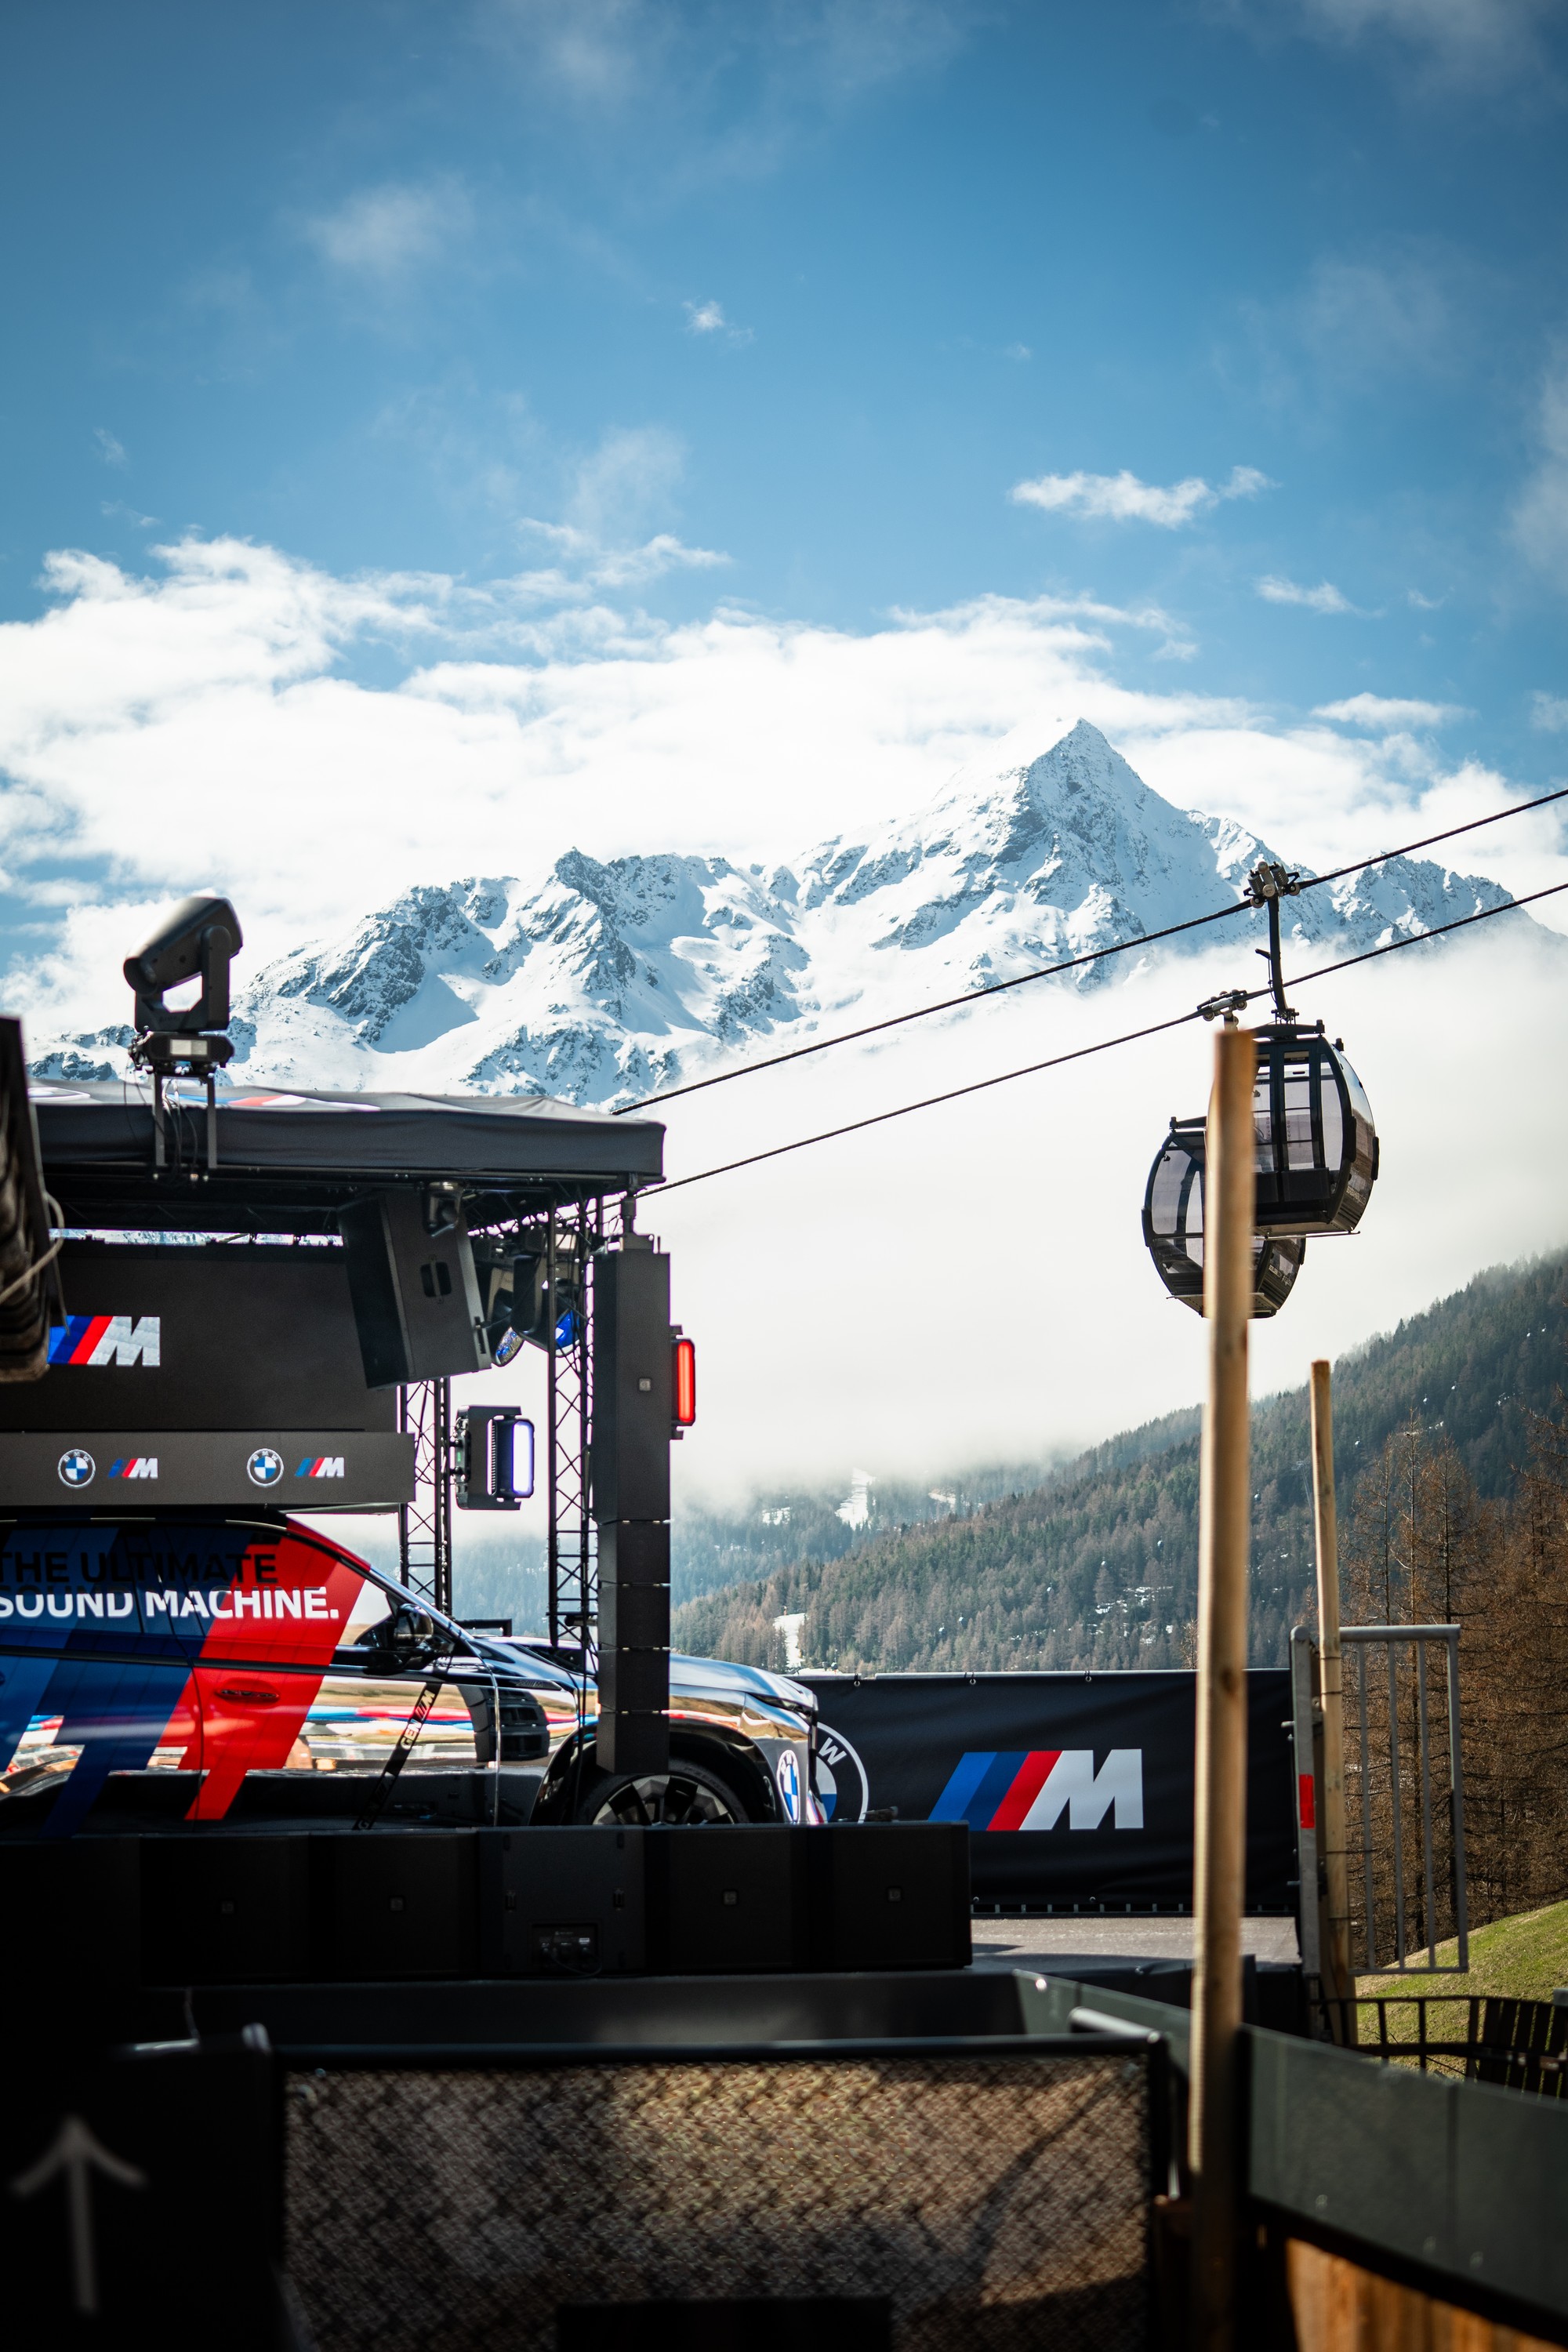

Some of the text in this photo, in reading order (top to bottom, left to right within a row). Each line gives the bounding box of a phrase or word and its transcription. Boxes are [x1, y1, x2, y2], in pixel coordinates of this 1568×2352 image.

[0, 1552, 278, 1584] THE ULTIMATE
[0, 1585, 339, 1619] SOUND MACHINE.
[1018, 1749, 1144, 1831] M
